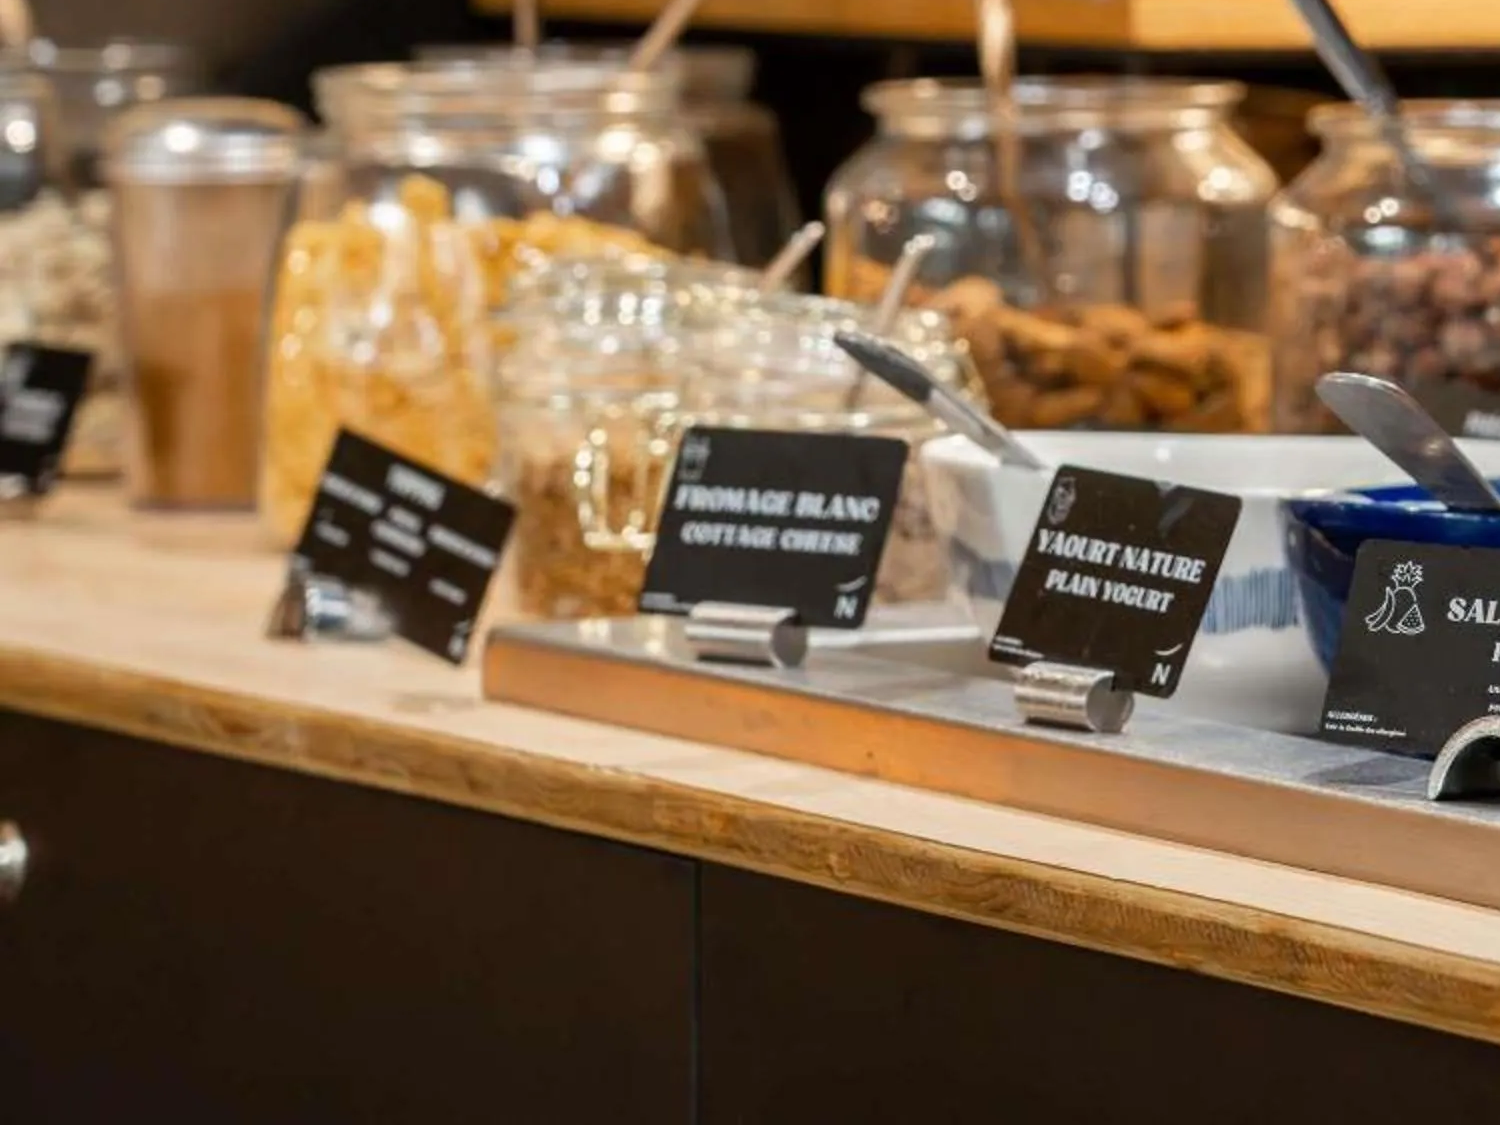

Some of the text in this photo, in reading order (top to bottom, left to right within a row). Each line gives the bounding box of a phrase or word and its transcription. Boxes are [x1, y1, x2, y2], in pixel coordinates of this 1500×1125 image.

[1037, 529, 1205, 582] YAOURT NATURE
[1045, 569, 1174, 612] PLAIN YOGURT
